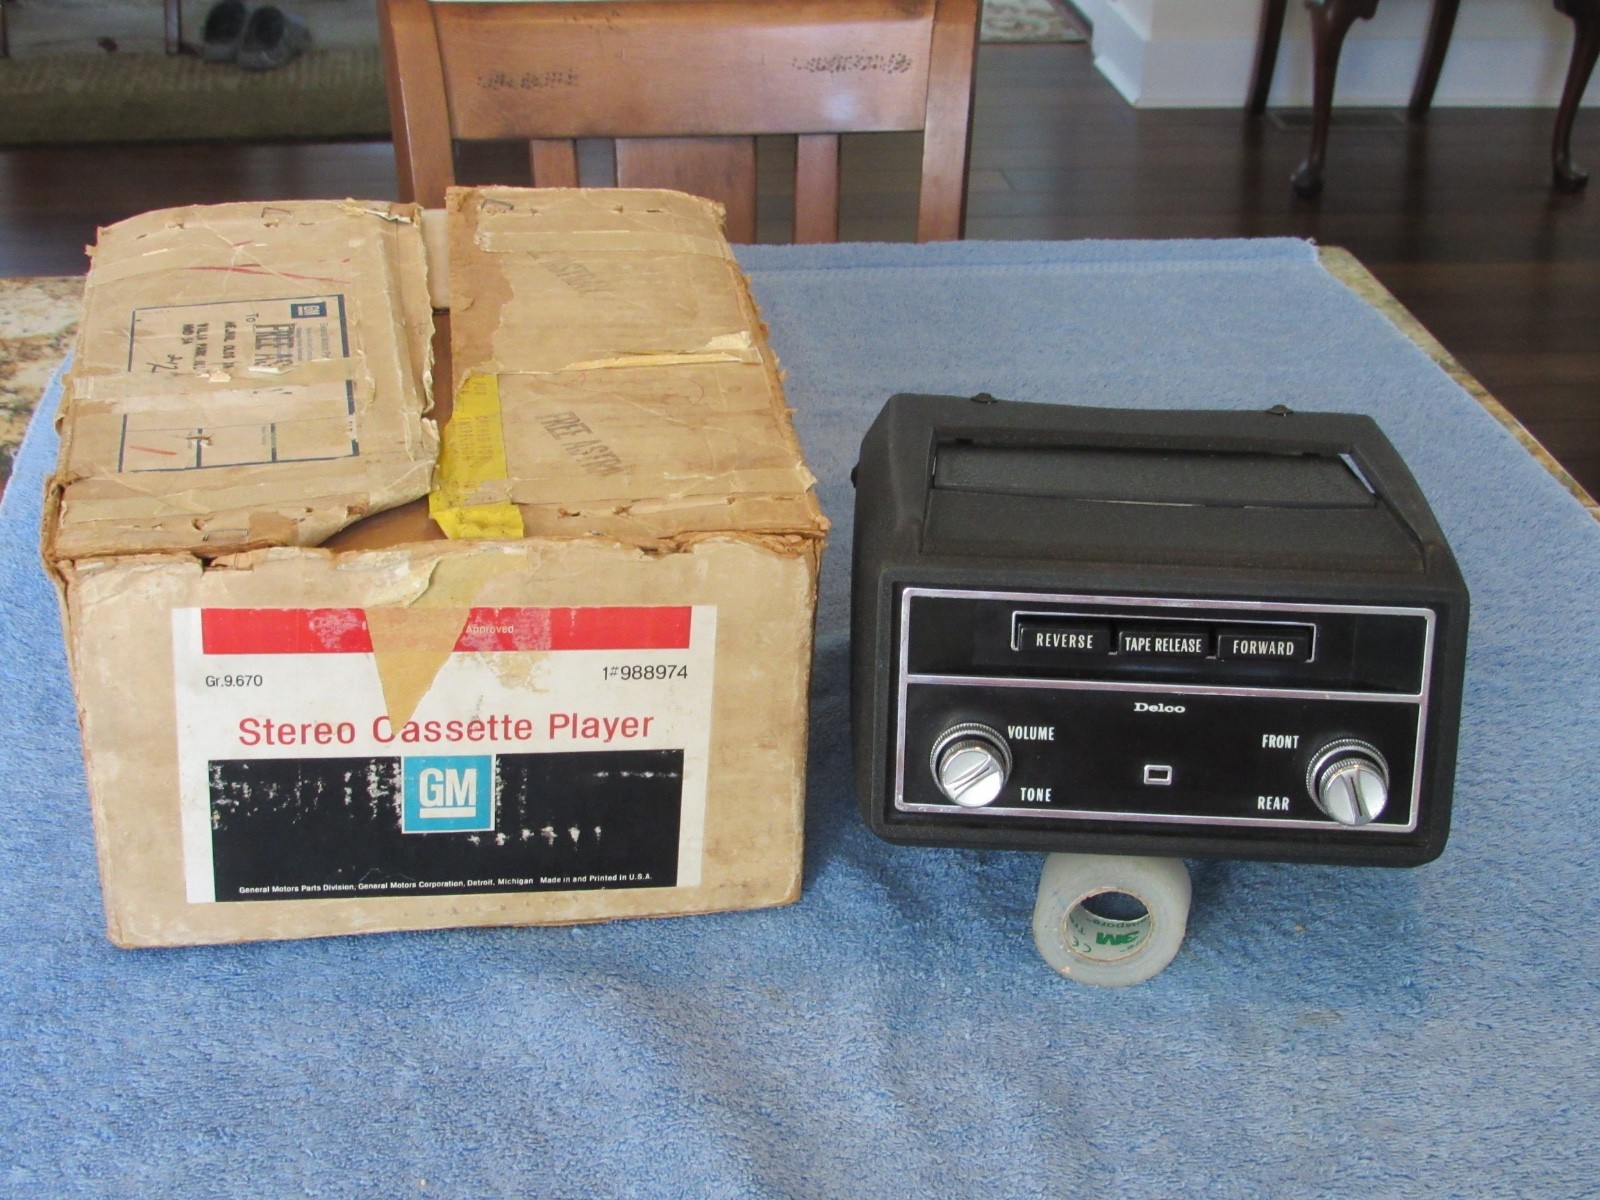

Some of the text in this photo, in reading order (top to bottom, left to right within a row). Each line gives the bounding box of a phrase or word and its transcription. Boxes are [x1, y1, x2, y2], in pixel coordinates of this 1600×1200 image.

[246, 312, 259, 322] To
[465, 624, 515, 636] Approved
[1036, 633, 1093, 649] REVERSE
[1124, 637, 1202, 653] TAPE RELEASE
[1233, 640, 1294, 656] FORWARD
[602, 665, 688, 681] 1#988974
[205, 674, 263, 688] Gr.9.670
[1134, 702, 1186, 713] Delco
[238, 713, 654, 746] Stereo Cassette Player
[1007, 725, 1055, 741] VOLUME
[1262, 734, 1299, 749] FRONT
[419, 767, 477, 808] GM
[1020, 787, 1052, 802] TONE
[1257, 796, 1290, 810] REAR
[239, 886, 270, 894] General
[272, 885, 299, 893] Motors
[301, 884, 321, 892] Parts
[323, 884, 357, 892] Division,
[358, 882, 388, 890] General
[418, 879, 466, 889] Corporation,
[467, 878, 495, 887] Detroit,
[497, 877, 533, 887] Michigan
[540, 876, 561, 884] Made
[563, 875, 571, 883] in
[572, 875, 587, 883] and
[589, 874, 617, 882] Printed
[619, 873, 627, 881] in
[629, 873, 653, 881] U.S.A.
[1096, 932, 1140, 946] 3M
